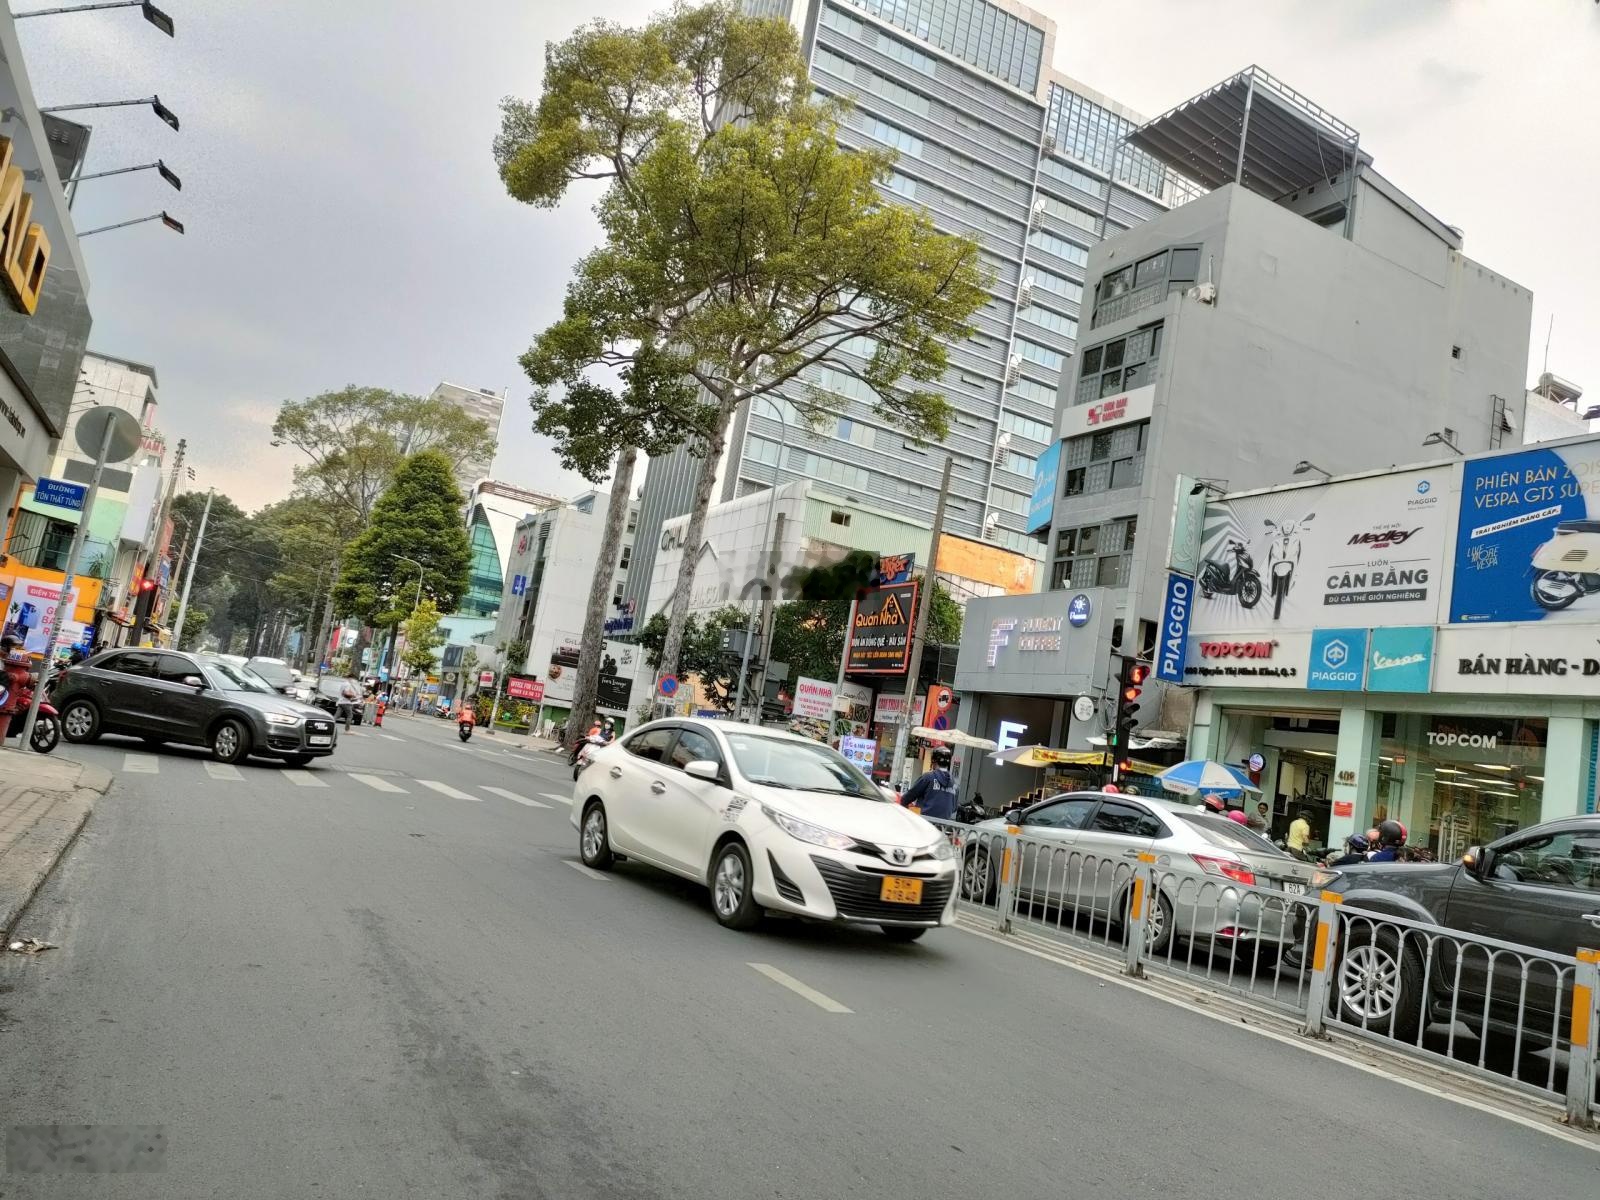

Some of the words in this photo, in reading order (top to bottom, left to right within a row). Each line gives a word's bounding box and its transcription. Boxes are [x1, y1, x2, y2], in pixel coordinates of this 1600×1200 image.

[1475, 471, 1520, 491] PHIÊN
[1525, 464, 1559, 484] BẢN
[37, 491, 50, 500] TÔN
[50, 493, 65, 504] THẤT
[47, 483, 76, 495] ĐƯỜNG
[1475, 492, 1520, 509] VESPA
[1524, 485, 1555, 503] GTS
[1407, 497, 1438, 506] PIAGGIO
[1347, 527, 1424, 546] Medley
[1367, 559, 1389, 567] LUÔN
[1326, 571, 1367, 589] CÂN
[1371, 566, 1429, 587] BẰNG
[856, 611, 880, 627] Quán
[1163, 581, 1188, 675] PIAGGIO
[1200, 642, 1272, 658] TOPCOM
[1373, 651, 1427, 671] Vespa
[1458, 653, 1502, 675] BÁN
[1504, 653, 1568, 676] HÀNG
[1290, 667, 1297, 676] 3
[1311, 671, 1356, 681] PIAGGIO
[1426, 731, 1497, 749] TOPCOM
